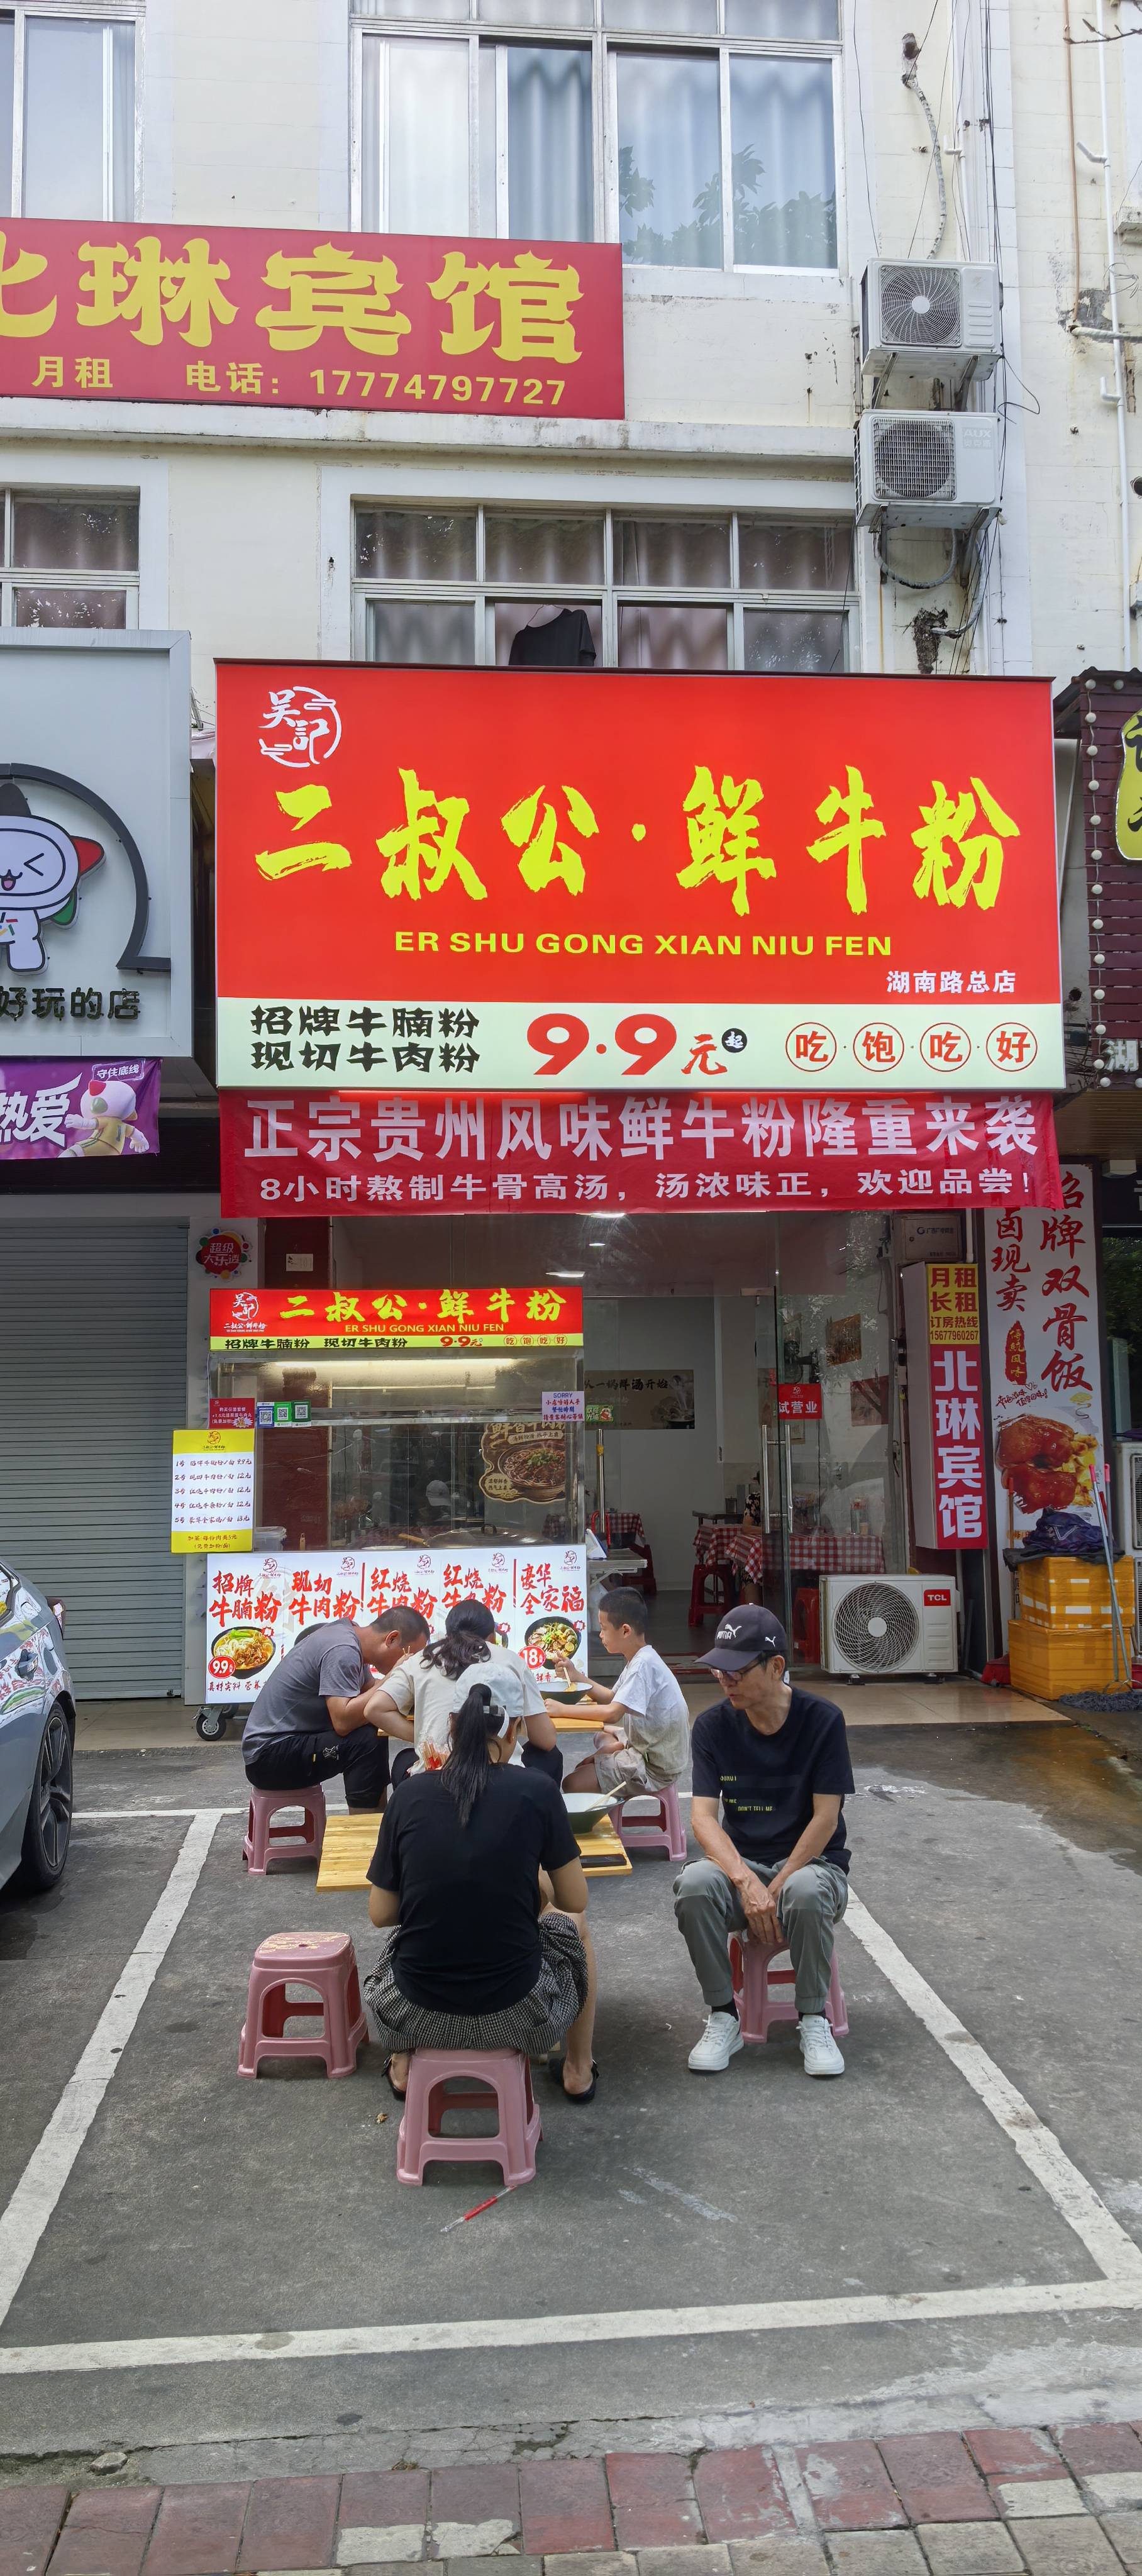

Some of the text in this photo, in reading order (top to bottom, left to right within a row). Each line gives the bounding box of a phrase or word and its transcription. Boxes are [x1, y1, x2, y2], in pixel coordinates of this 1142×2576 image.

[31, 356, 113, 388] 月租
[395, 931, 892, 955] ER SHU GONG XIAN NIU FEN
[886, 970, 1016, 994] 湖南路总店
[251, 1004, 480, 1039] 招牌牛腩粉
[251, 1041, 480, 1073] 现切牛肉粉
[96, 1063, 140, 1079] 守住底线
[244, 1094, 1039, 1162] 正宗贵州风味鲜牛粉隆重来袭
[210, 1243, 233, 1253] 超级
[931, 1267, 977, 1288] 月租
[930, 1291, 978, 1313] 长租
[459, 1324, 479, 1332] NIU
[483, 1323, 504, 1331] FEN
[930, 1316, 978, 1328] 订房热线
[225, 1338, 311, 1349] 招牌牛腩粉
[324, 1337, 408, 1348] 现切牛肉粉
[930, 1330, 979, 1340] 15677960267
[779, 1401, 818, 1414] 试营业
[933, 1350, 983, 1540] 北琳宾馆
[212, 1570, 254, 1597] 招牌
[291, 1569, 333, 1595] 现切
[370, 1567, 412, 1592] 红烧
[443, 1563, 484, 1589] 红烧
[521, 1563, 552, 1590] 豪华
[209, 1591, 282, 1628] 牛腩粉
[289, 1589, 360, 1626] 牛肉粉
[520, 1584, 585, 1615] 全家福
